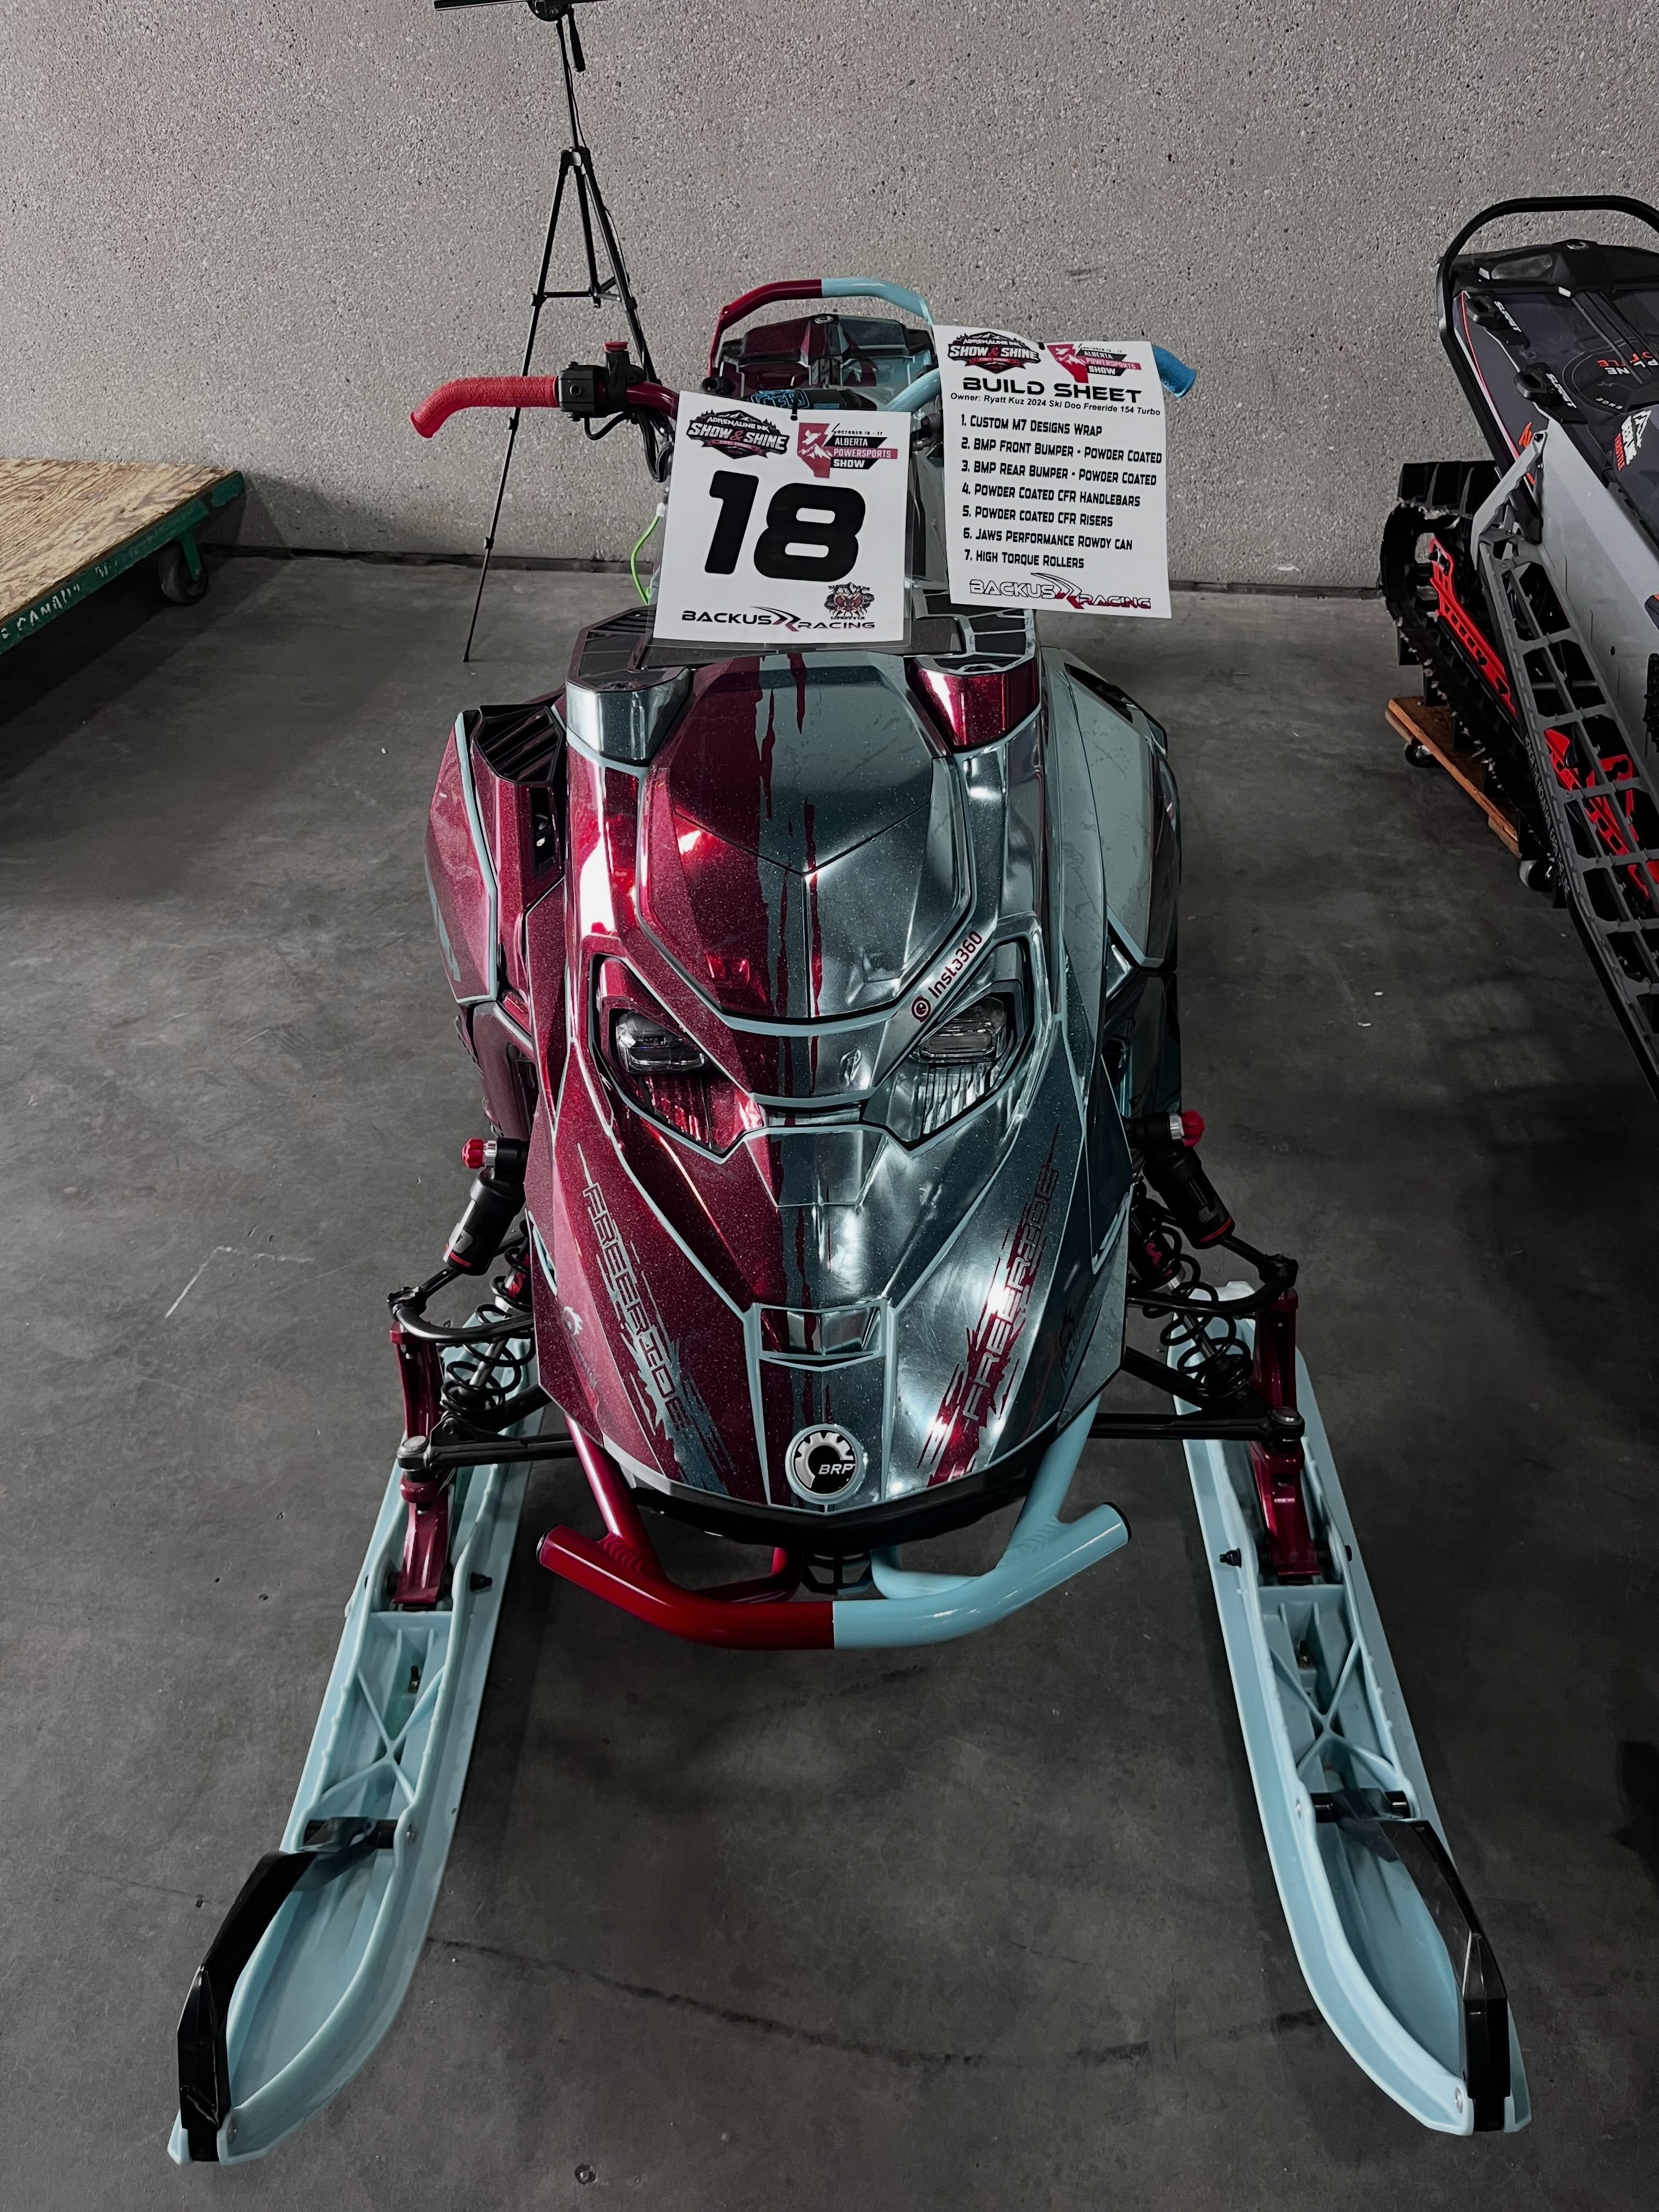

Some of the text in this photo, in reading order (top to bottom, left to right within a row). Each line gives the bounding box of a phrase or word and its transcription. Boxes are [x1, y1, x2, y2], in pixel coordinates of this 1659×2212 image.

[949, 345, 1039, 360] SHOW & SHINE
[1084, 351, 1113, 359] ALBERTA
[1086, 358, 1136, 369] POWERSPORTS
[1088, 365, 1116, 375] SHOW
[963, 377, 1142, 403] BUILD SHEET
[950, 392, 981, 401] Owner:
[984, 394, 1006, 404] Ryatt
[1008, 396, 1025, 405] Kuz
[1027, 398, 1046, 407] 2024
[1064, 401, 1081, 409] Doo
[1084, 403, 1118, 412] Freeride
[1120, 405, 1134, 414] 154
[1137, 407, 1160, 416] Turbo
[706, 416, 770, 433] ADRENALINE INK
[961, 414, 1102, 437] 1. CUSTOM M7 DESIGNS WRAP
[688, 422, 788, 450] SHOW & SHINE
[834, 437, 868, 447] ALBERTA
[833, 448, 891, 458] POWERSPORTS
[961, 437, 970, 450] 2.
[973, 438, 996, 451] BMP
[1000, 439, 1031, 454] FRONT
[1034, 442, 1074, 458] BUMPER
[1084, 446, 1124, 461] POWDER
[1127, 449, 1162, 464] COATED
[833, 459, 865, 468] SHOW
[961, 459, 970, 472] 3.
[973, 460, 996, 474] BMP
[1000, 462, 1026, 476] REAR
[1029, 465, 1068, 479] BUMPER
[1079, 468, 1119, 483] POWDER
[1122, 472, 1157, 486] COATED
[961, 482, 1141, 507] 4. POWDER COATED CFR HANDLEBARS
[704, 470, 866, 583] 18
[962, 505, 1113, 527] 5. POWDER COATED CFR RISERS
[963, 527, 1133, 550] 6. JAWS PERFORMANCE ROWDY CAN
[964, 549, 1084, 569] 7. HIGH TORQUE ROLLERS
[969, 579, 1152, 609] BACKUS RACING
[681, 610, 876, 629] BACKUS RACING
[818, 1463, 854, 1475] BRP
